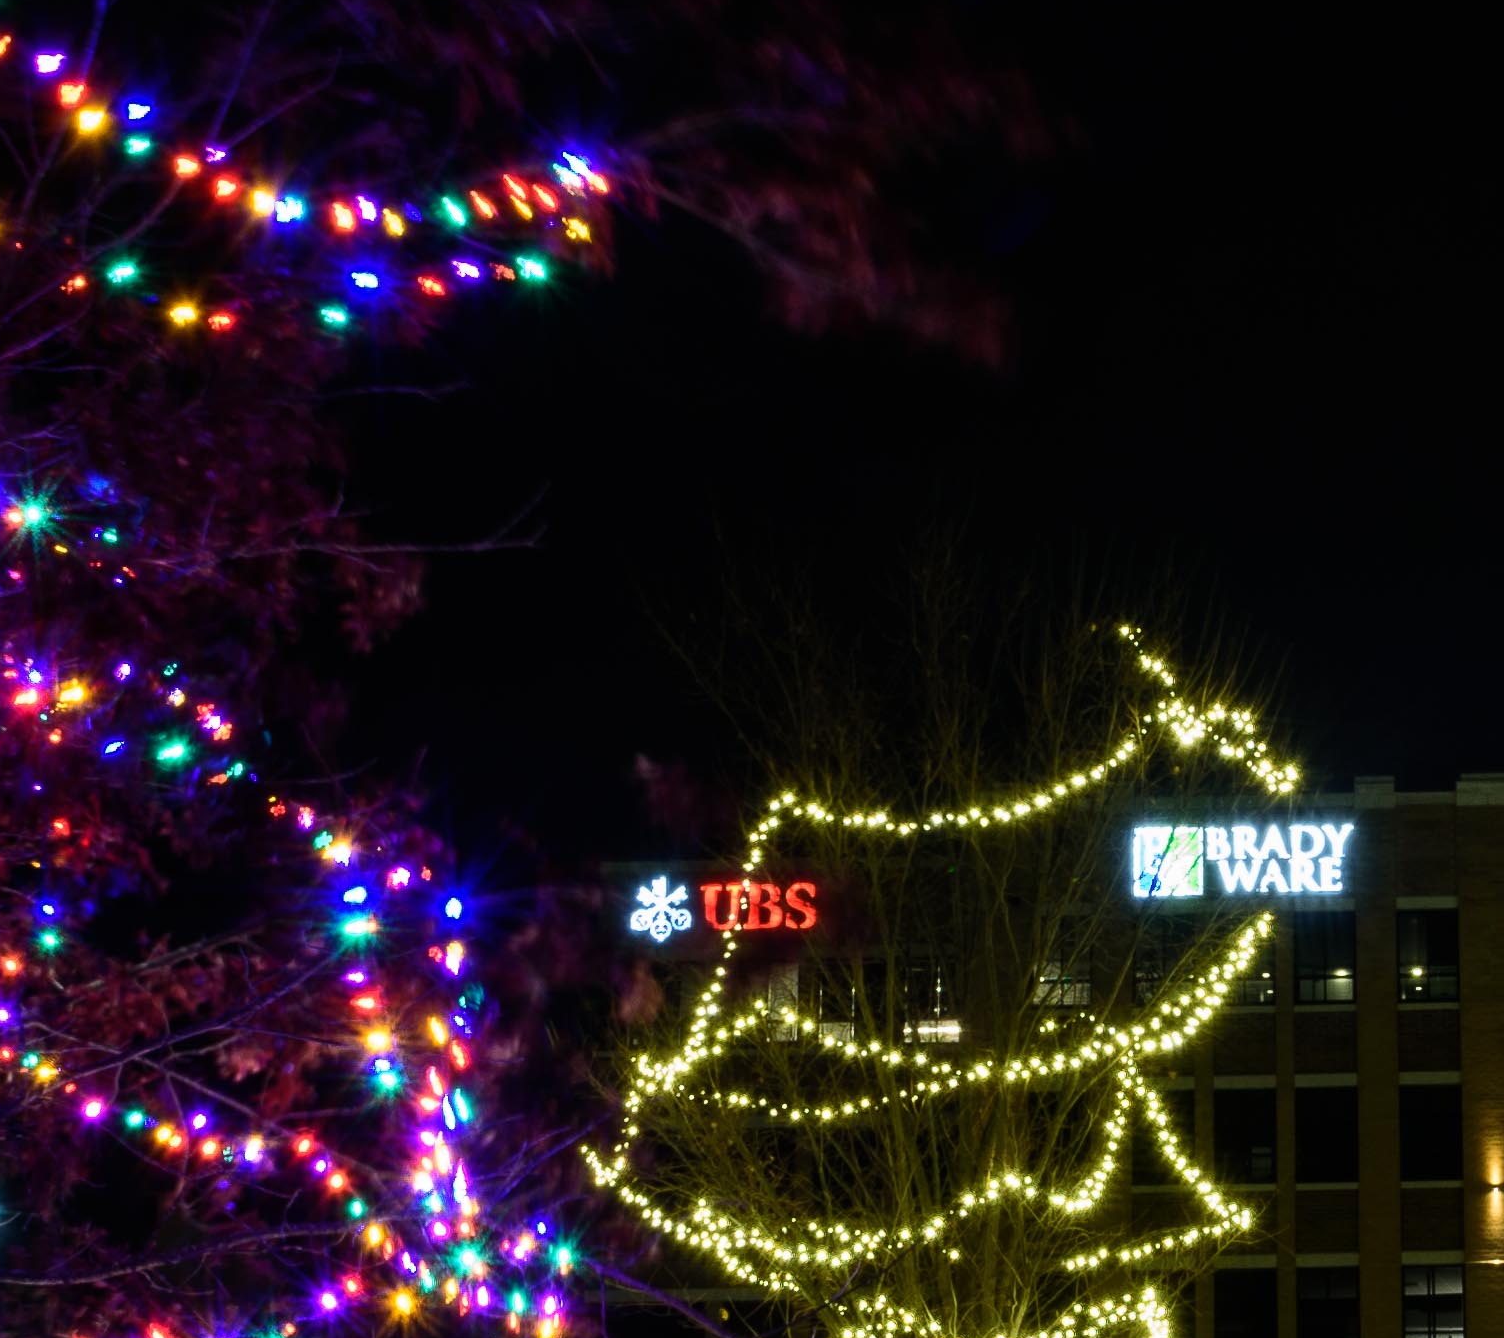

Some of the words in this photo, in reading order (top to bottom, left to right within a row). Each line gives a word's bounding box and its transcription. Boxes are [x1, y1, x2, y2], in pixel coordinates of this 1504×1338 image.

[1205, 824, 1354, 861] BRADY
[1217, 858, 1344, 894] WARE
[700, 882, 817, 930] UBS
